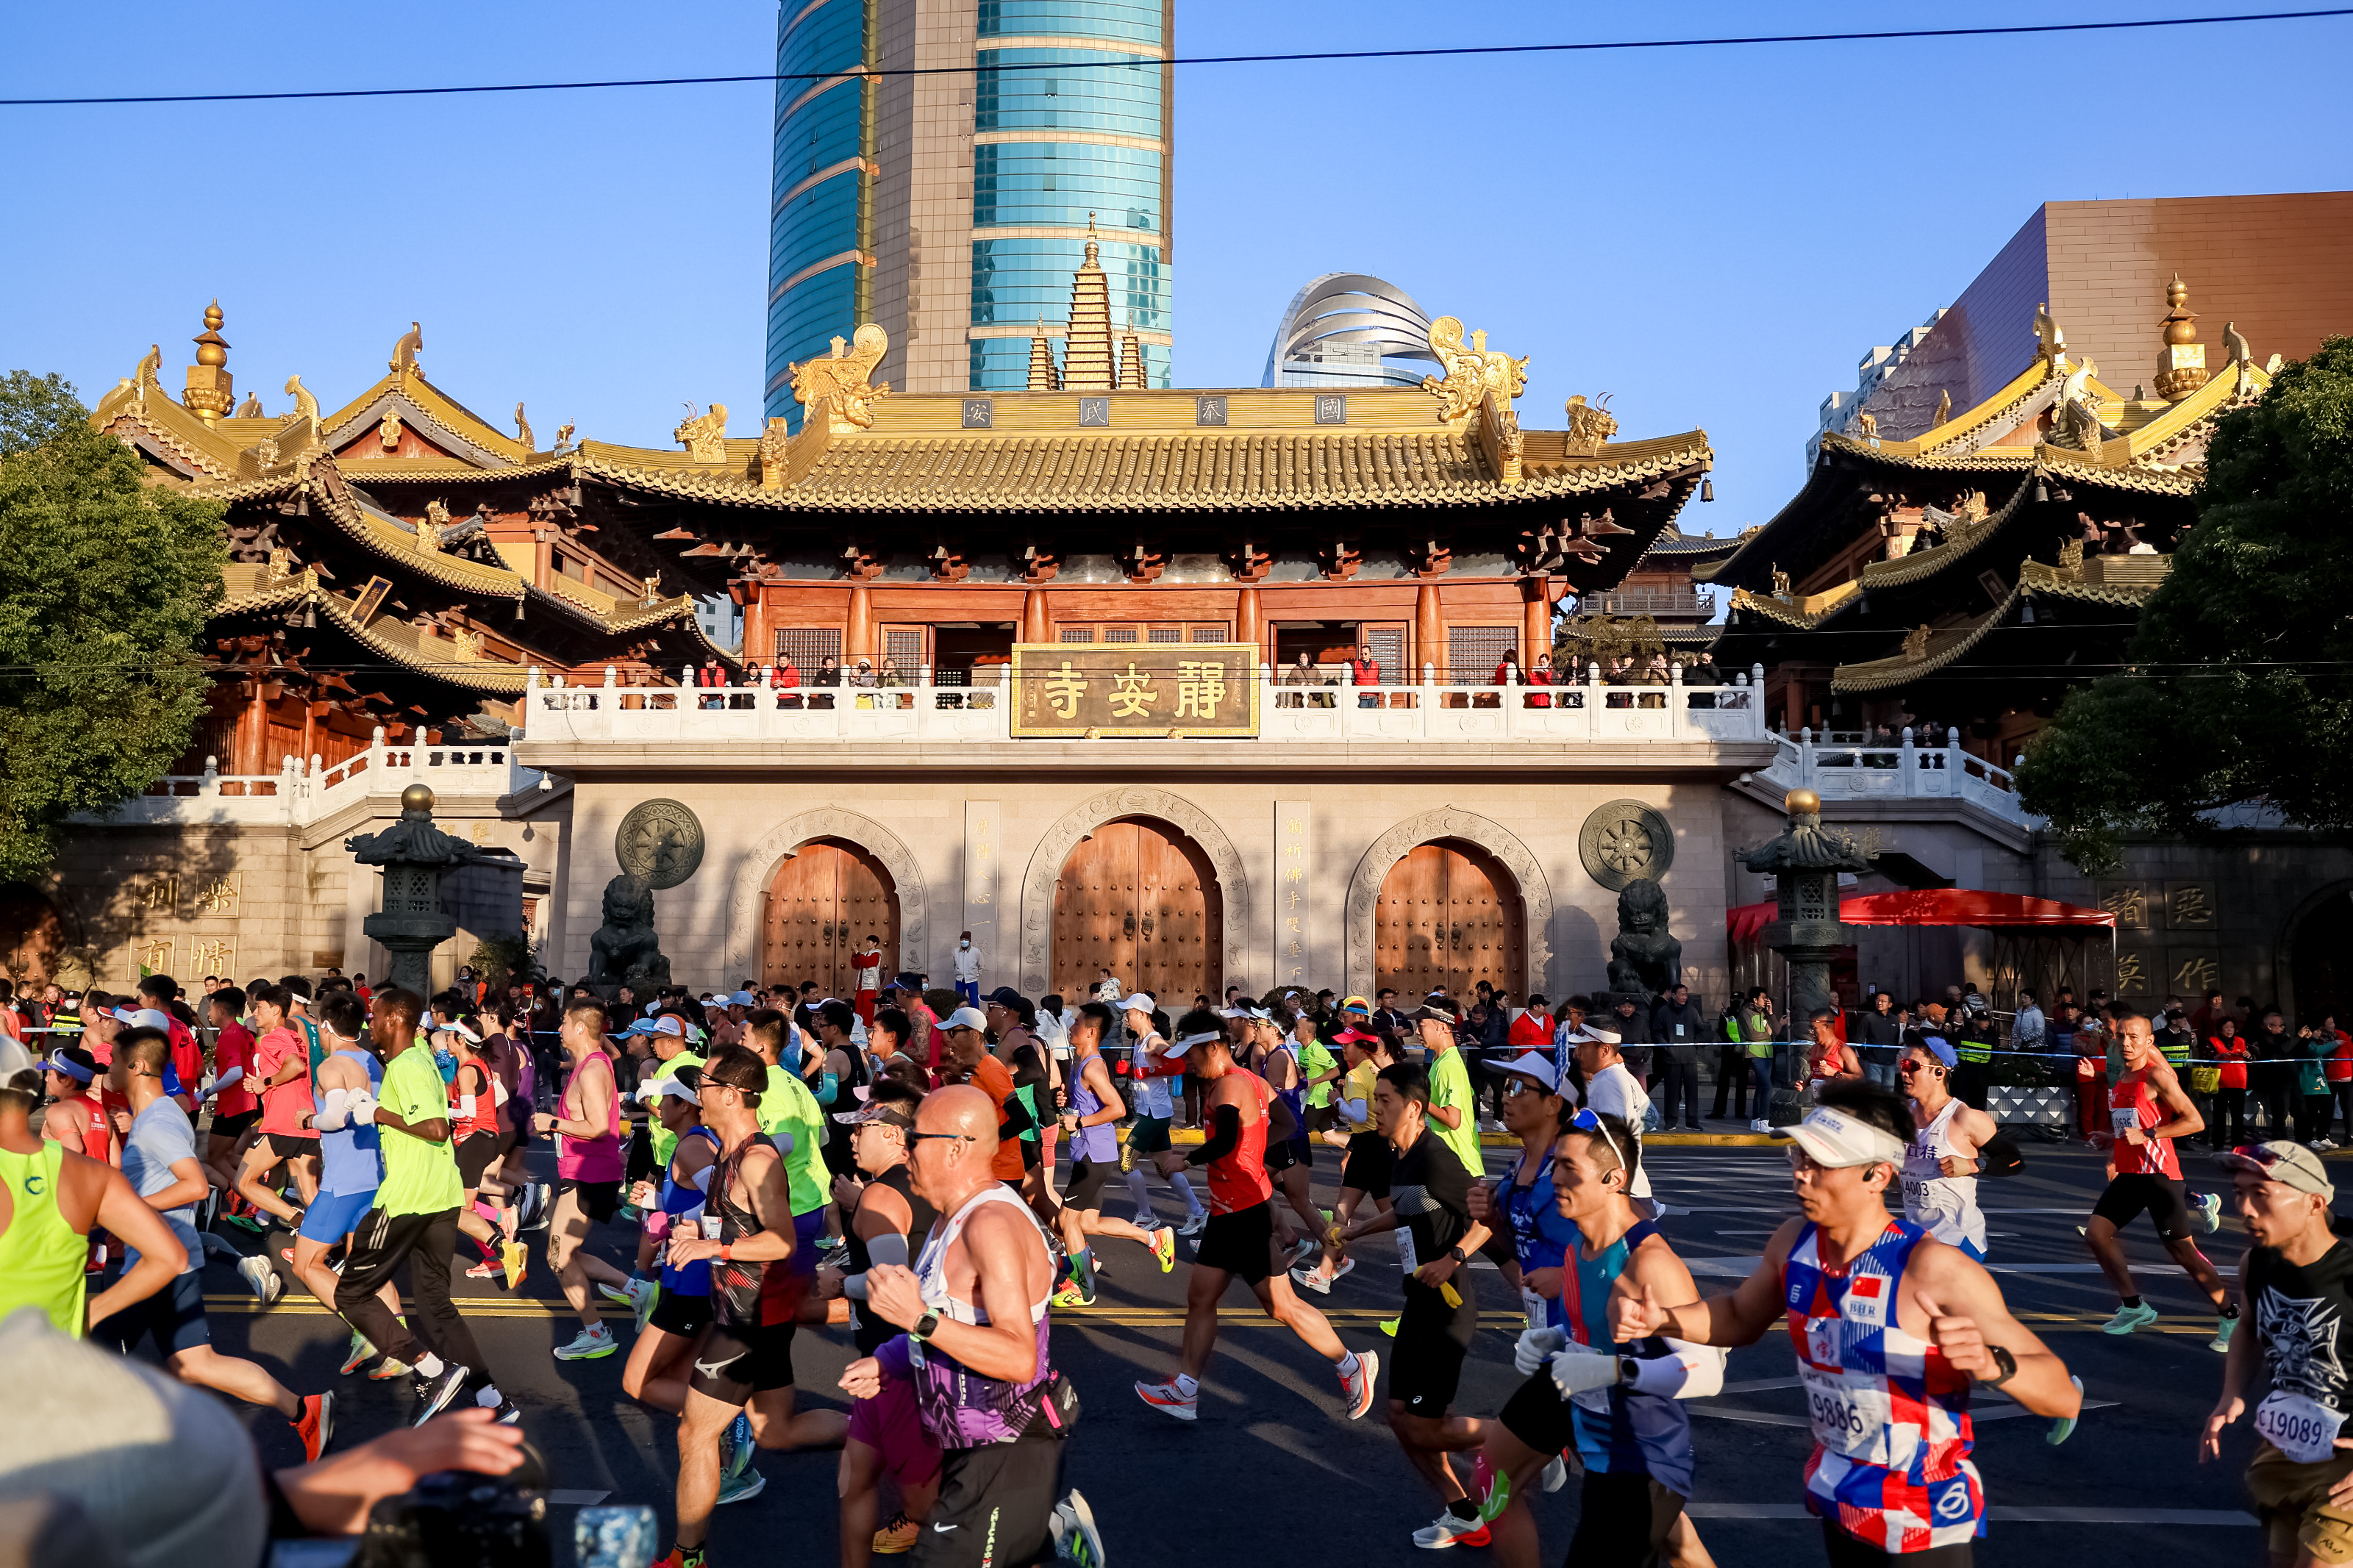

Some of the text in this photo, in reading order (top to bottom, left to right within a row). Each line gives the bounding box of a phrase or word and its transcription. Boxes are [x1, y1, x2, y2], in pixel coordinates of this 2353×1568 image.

[1044, 660, 1227, 720] 靜安寺
[135, 876, 238, 913] 利樂
[971, 816, 992, 972] 摩得人心一樣
[1282, 817, 1304, 982] 願祈佛手雙垂下
[2101, 884, 2213, 924] 諸惡
[131, 939, 233, 976] 有情
[1903, 1144, 1938, 1161] 比特
[1849, 1303, 1877, 1315] BHR
[735, 1417, 746, 1443] HOKA
[1812, 1392, 1864, 1434] 9886
